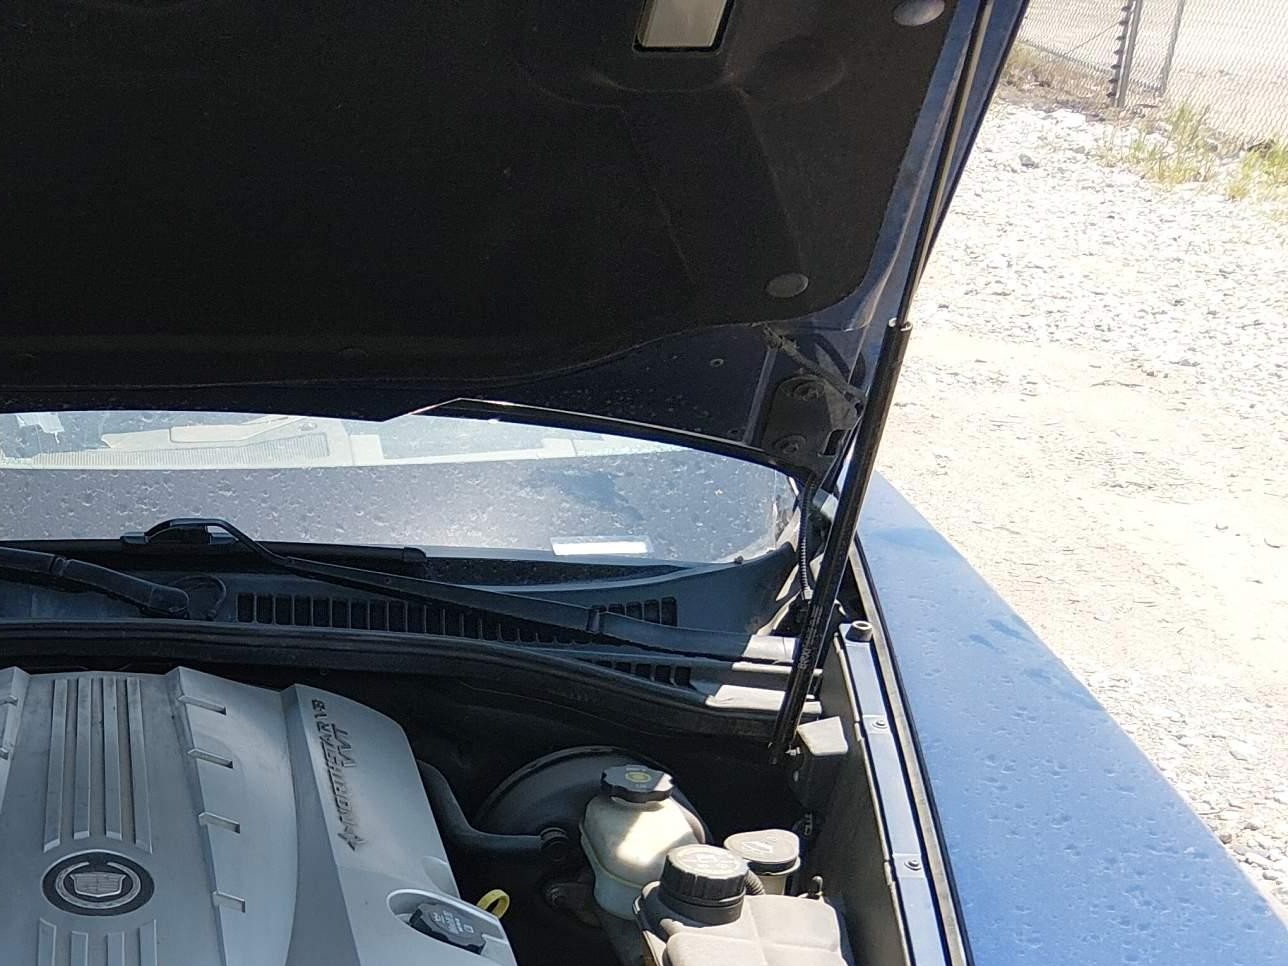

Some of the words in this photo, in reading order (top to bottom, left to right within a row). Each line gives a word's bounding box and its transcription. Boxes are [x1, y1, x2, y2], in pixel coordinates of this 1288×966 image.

[311, 698, 327, 720] V8
[331, 723, 357, 768] VVT
[317, 720, 359, 828] NORTHSTAR
